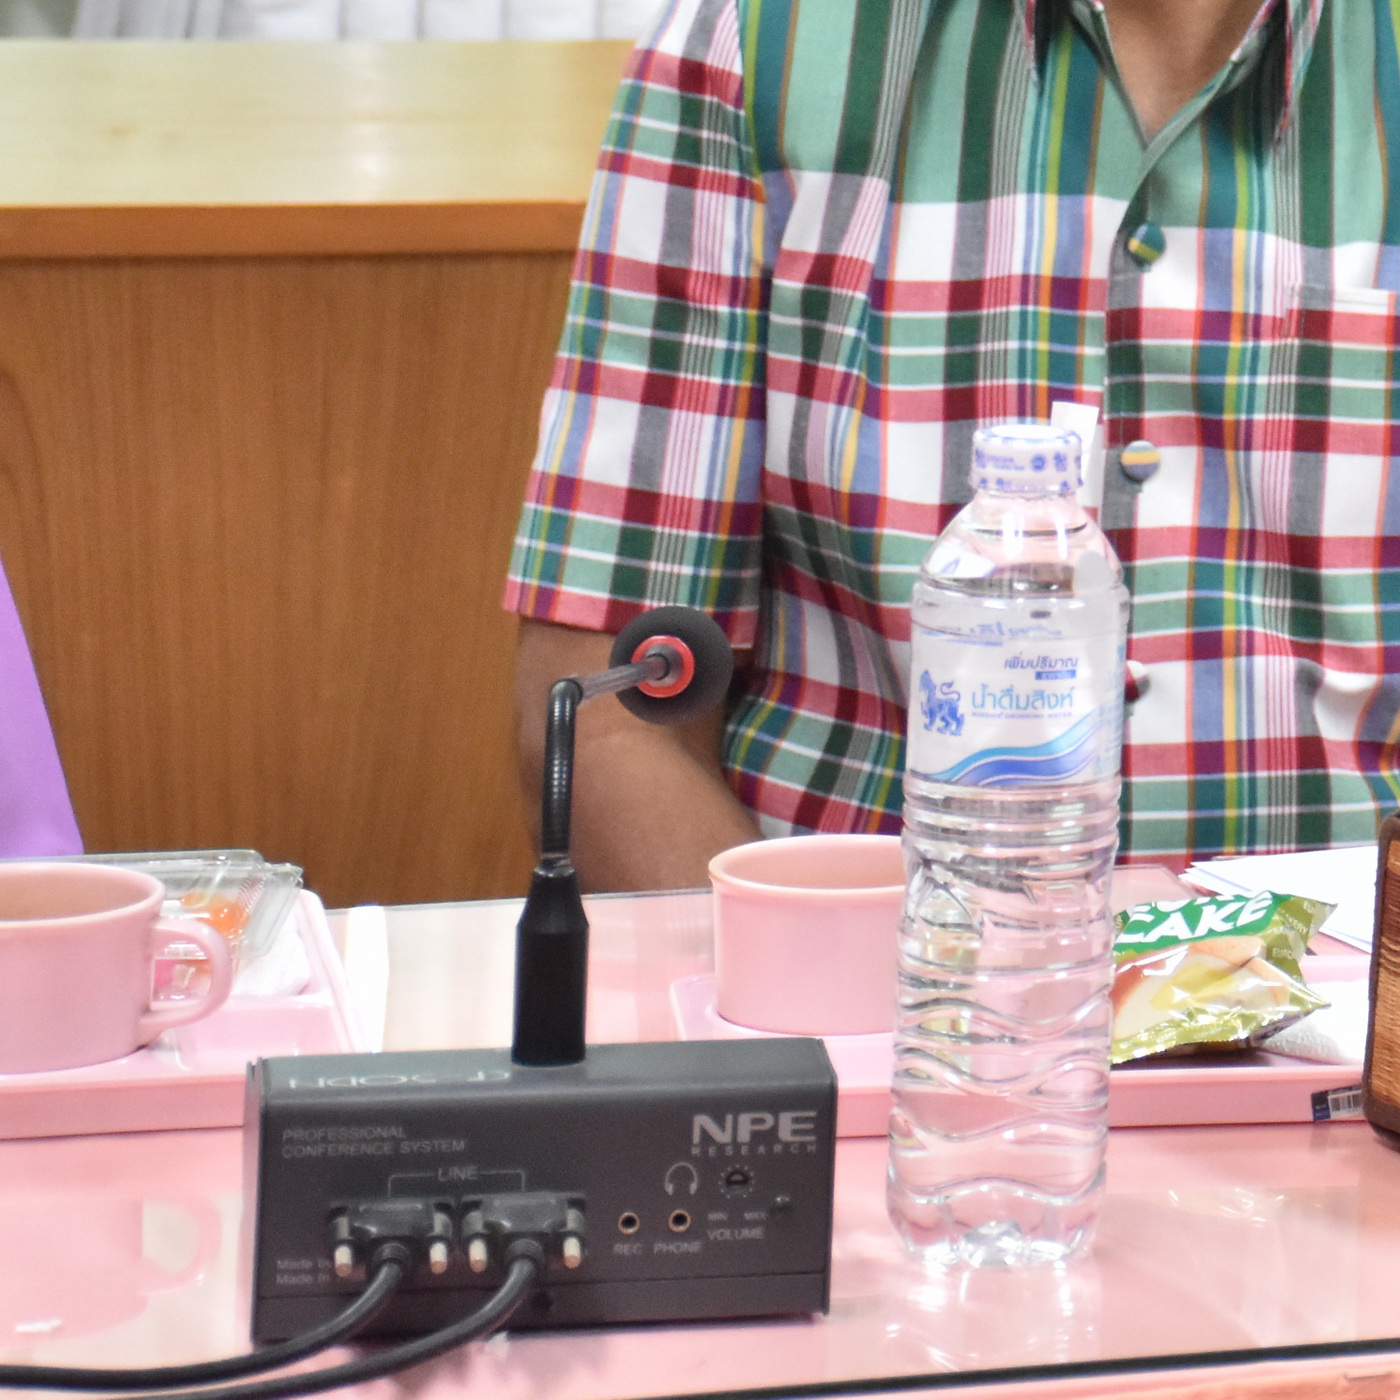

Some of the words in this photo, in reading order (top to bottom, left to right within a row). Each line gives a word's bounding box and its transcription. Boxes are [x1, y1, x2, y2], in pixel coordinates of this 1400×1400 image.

[972, 683, 1075, 710] น้ำดื่มสิงห์
[282, 1126, 406, 1142] PROFESSIONAL
[692, 1111, 818, 1145] NPE
[282, 1142, 394, 1159] CONFERENCE
[400, 1139, 466, 1154] SYSTEM
[691, 1144, 817, 1157] RESEARCH
[437, 1165, 479, 1182] LINE
[706, 1227, 765, 1241] VOLUME
[613, 1242, 643, 1255] REC
[653, 1241, 702, 1255] PHONE
